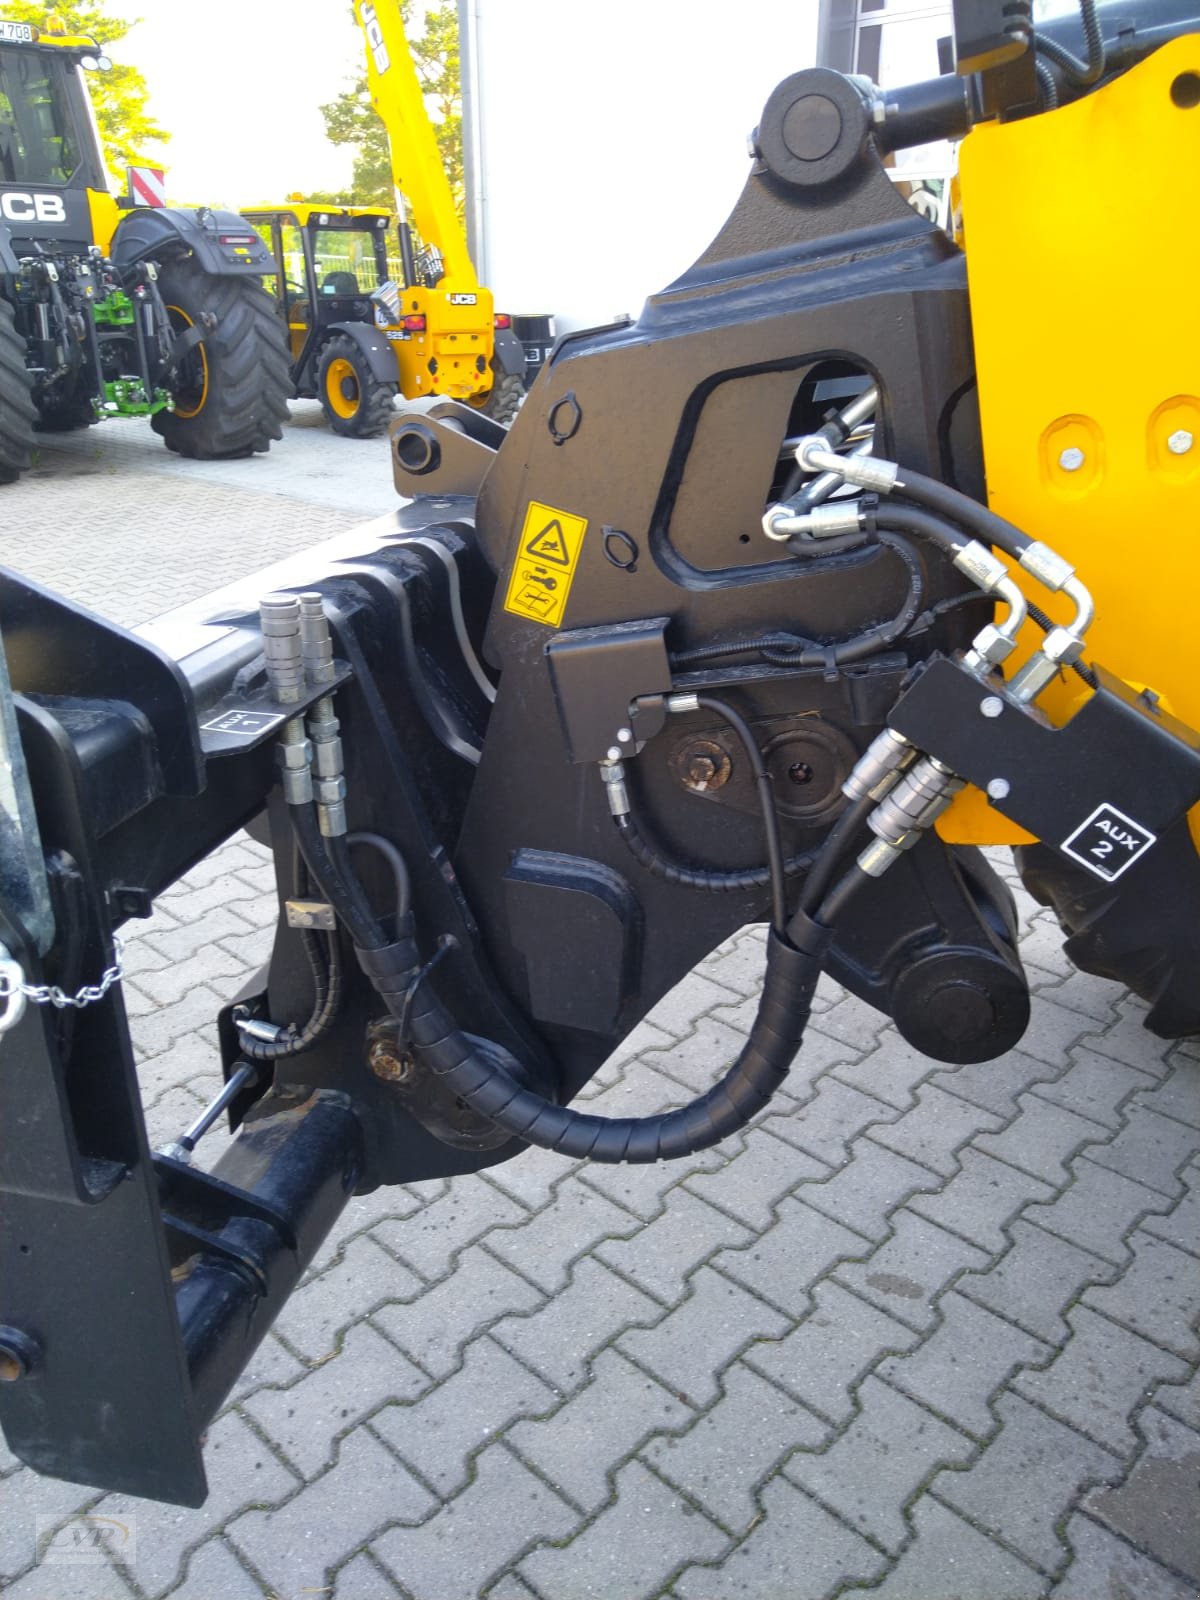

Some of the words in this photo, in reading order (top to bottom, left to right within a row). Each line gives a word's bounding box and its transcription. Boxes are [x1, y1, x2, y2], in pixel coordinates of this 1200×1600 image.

[8, 24, 30, 40] 708
[360, 1, 390, 74] JCB
[0, 192, 66, 222] CB
[451, 293, 477, 305] JCB
[218, 713, 248, 729] AUX
[1094, 820, 1141, 850] AUX
[1090, 840, 1114, 859] 2
